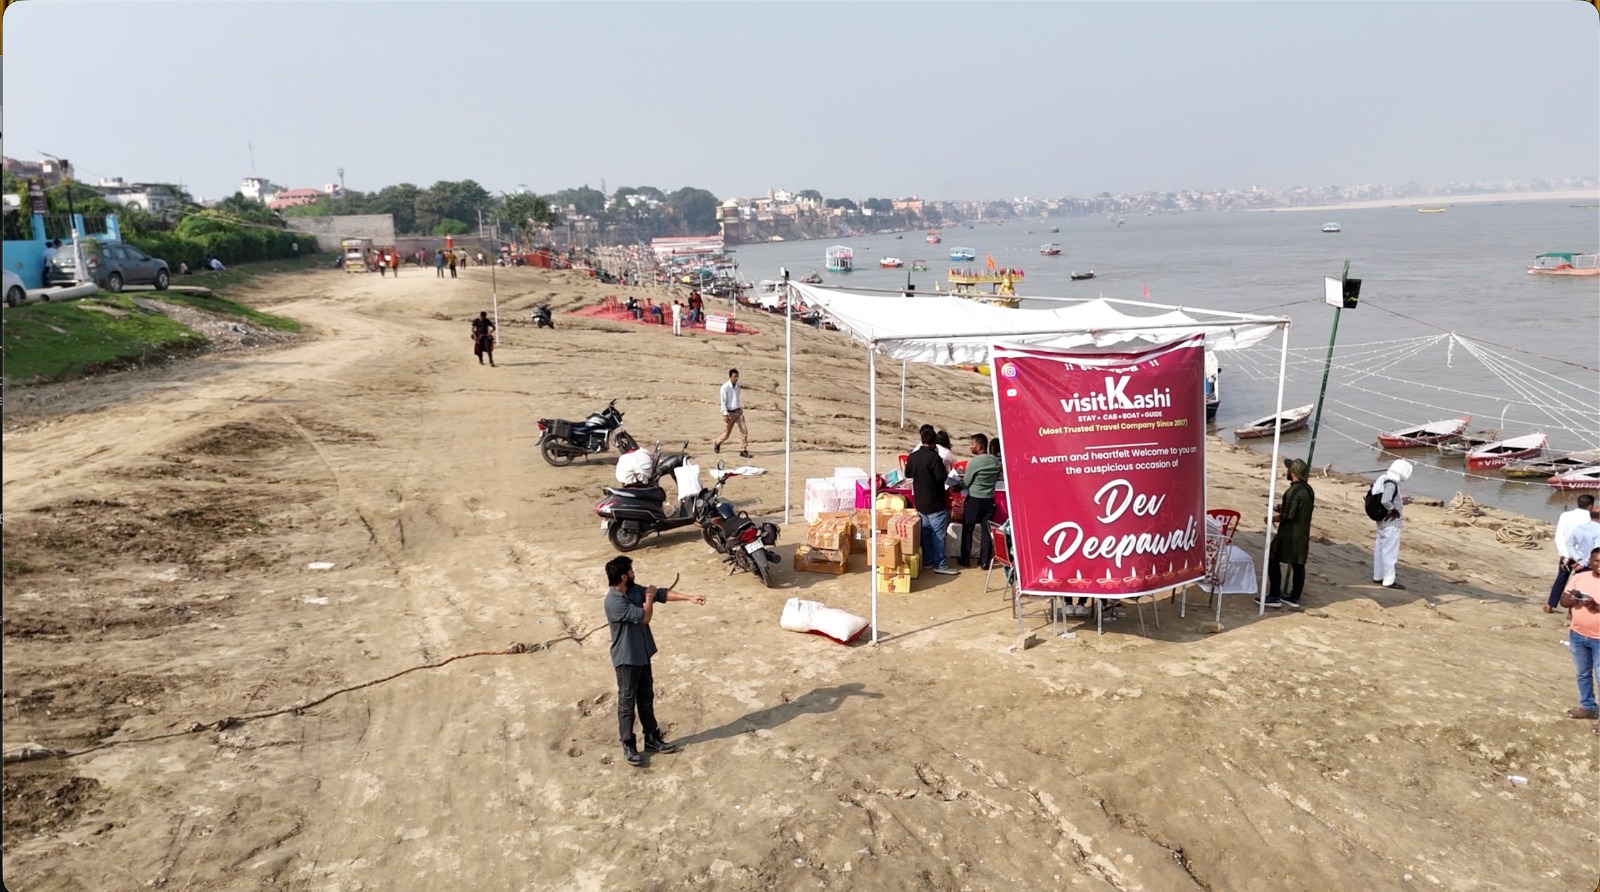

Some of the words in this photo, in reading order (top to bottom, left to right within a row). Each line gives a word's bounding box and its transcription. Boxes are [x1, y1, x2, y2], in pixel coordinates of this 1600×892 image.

[1078, 414, 1097, 423] STAY
[1103, 412, 1118, 420] CAB
[1122, 411, 1140, 420] BOAT
[1144, 410, 1163, 418] GUIDE
[1038, 426, 1063, 437] (Most
[1064, 424, 1095, 434] Trusted
[1096, 422, 1120, 432] Travel
[1121, 420, 1156, 431] Company
[1156, 419, 1174, 428] Since
[1031, 456, 1038, 464] A
[1039, 455, 1068, 463] warm
[1069, 452, 1089, 462] and
[1091, 448, 1131, 460] heartfelt
[1131, 448, 1169, 458] Welcome
[1170, 447, 1178, 455] to
[1178, 447, 1189, 456] you
[1065, 466, 1082, 475] the
[1084, 462, 1134, 475] auspicious
[1135, 459, 1171, 470] occasion
[1171, 459, 1179, 467] of
[1093, 478, 1166, 524] Dev
[1042, 515, 1199, 568] Deepawali
